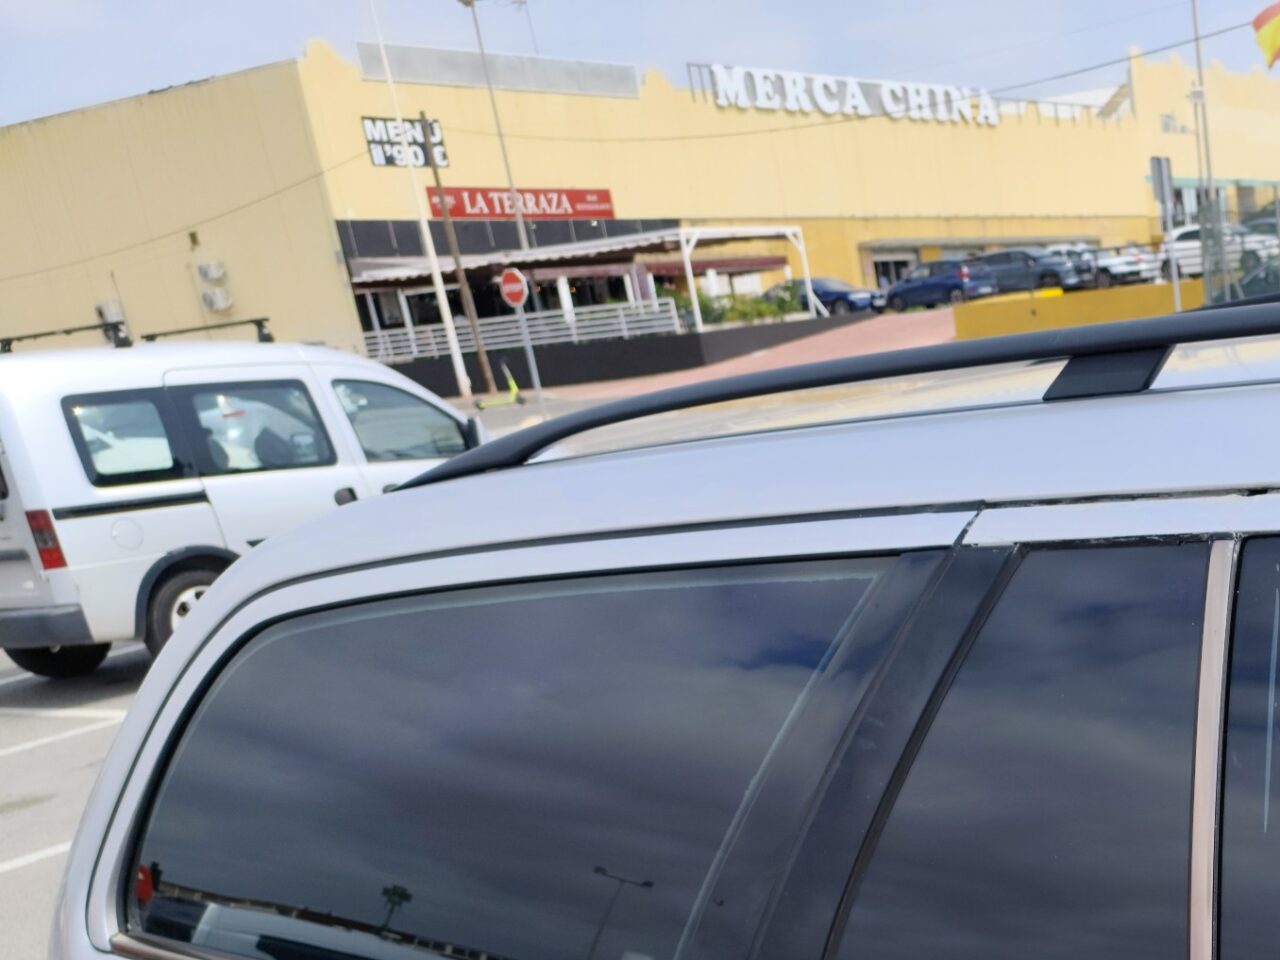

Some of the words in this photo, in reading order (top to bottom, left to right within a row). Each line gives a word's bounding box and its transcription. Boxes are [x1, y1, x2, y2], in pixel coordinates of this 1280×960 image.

[711, 64, 871, 117] MERCA
[880, 78, 999, 126] CHINA
[461, 191, 489, 214] LA
[488, 192, 574, 214] TERRAZA
